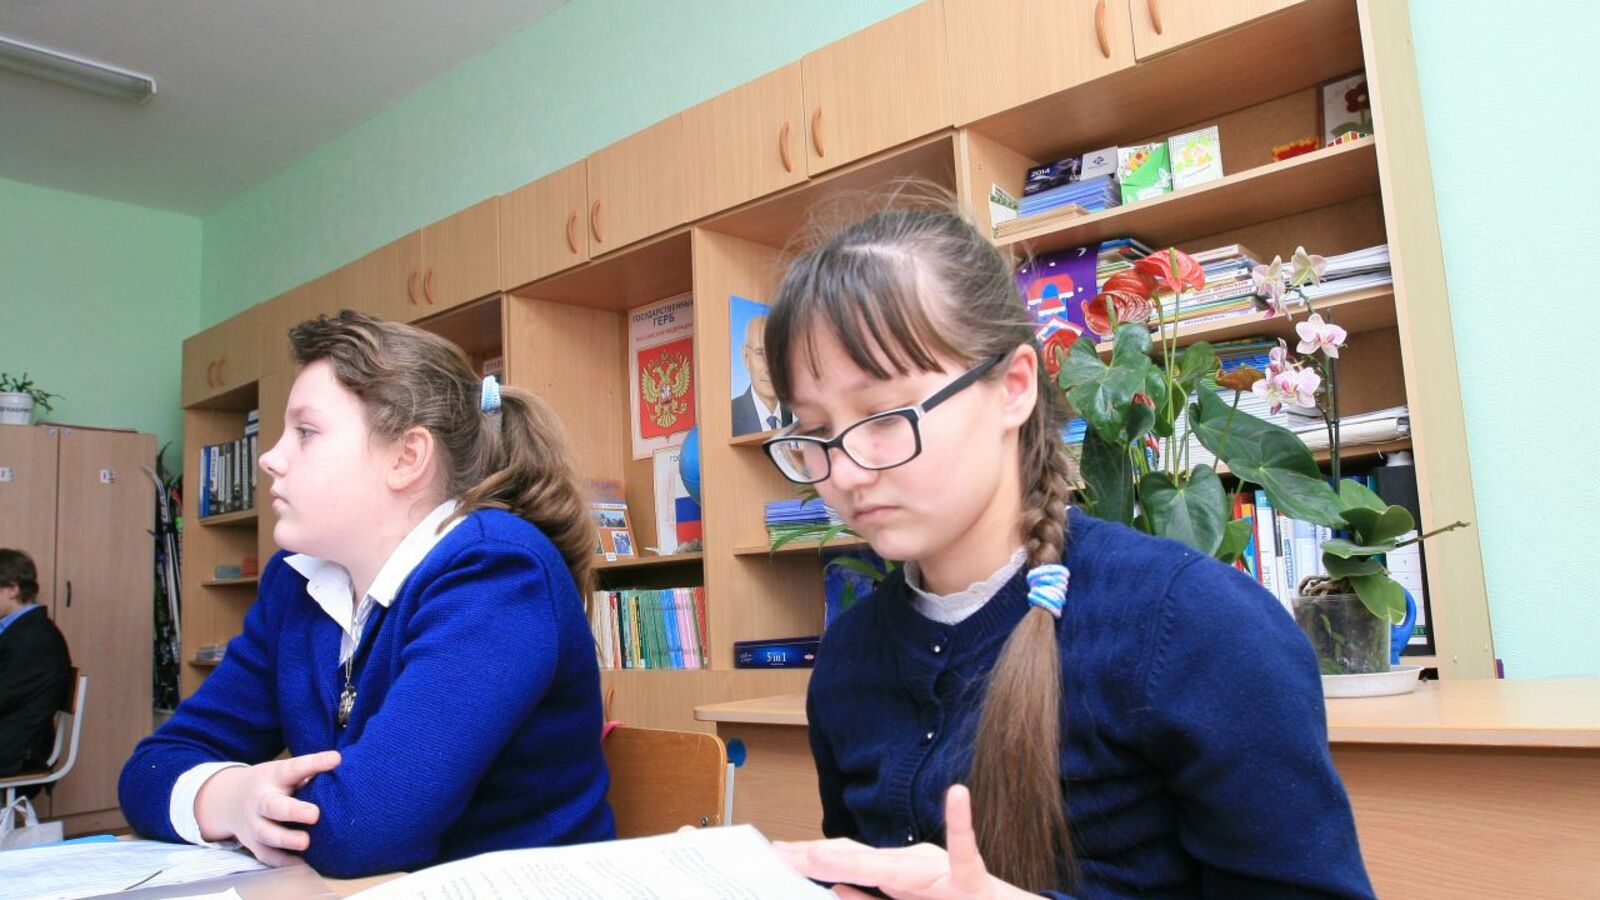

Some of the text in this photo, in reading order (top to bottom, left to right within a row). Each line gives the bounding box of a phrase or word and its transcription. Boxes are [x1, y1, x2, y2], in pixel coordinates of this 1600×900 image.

[1031, 167, 1051, 177] 2014
[653, 314, 675, 327] ГЕРБ
[766, 652, 786, 662] 5 in 1
